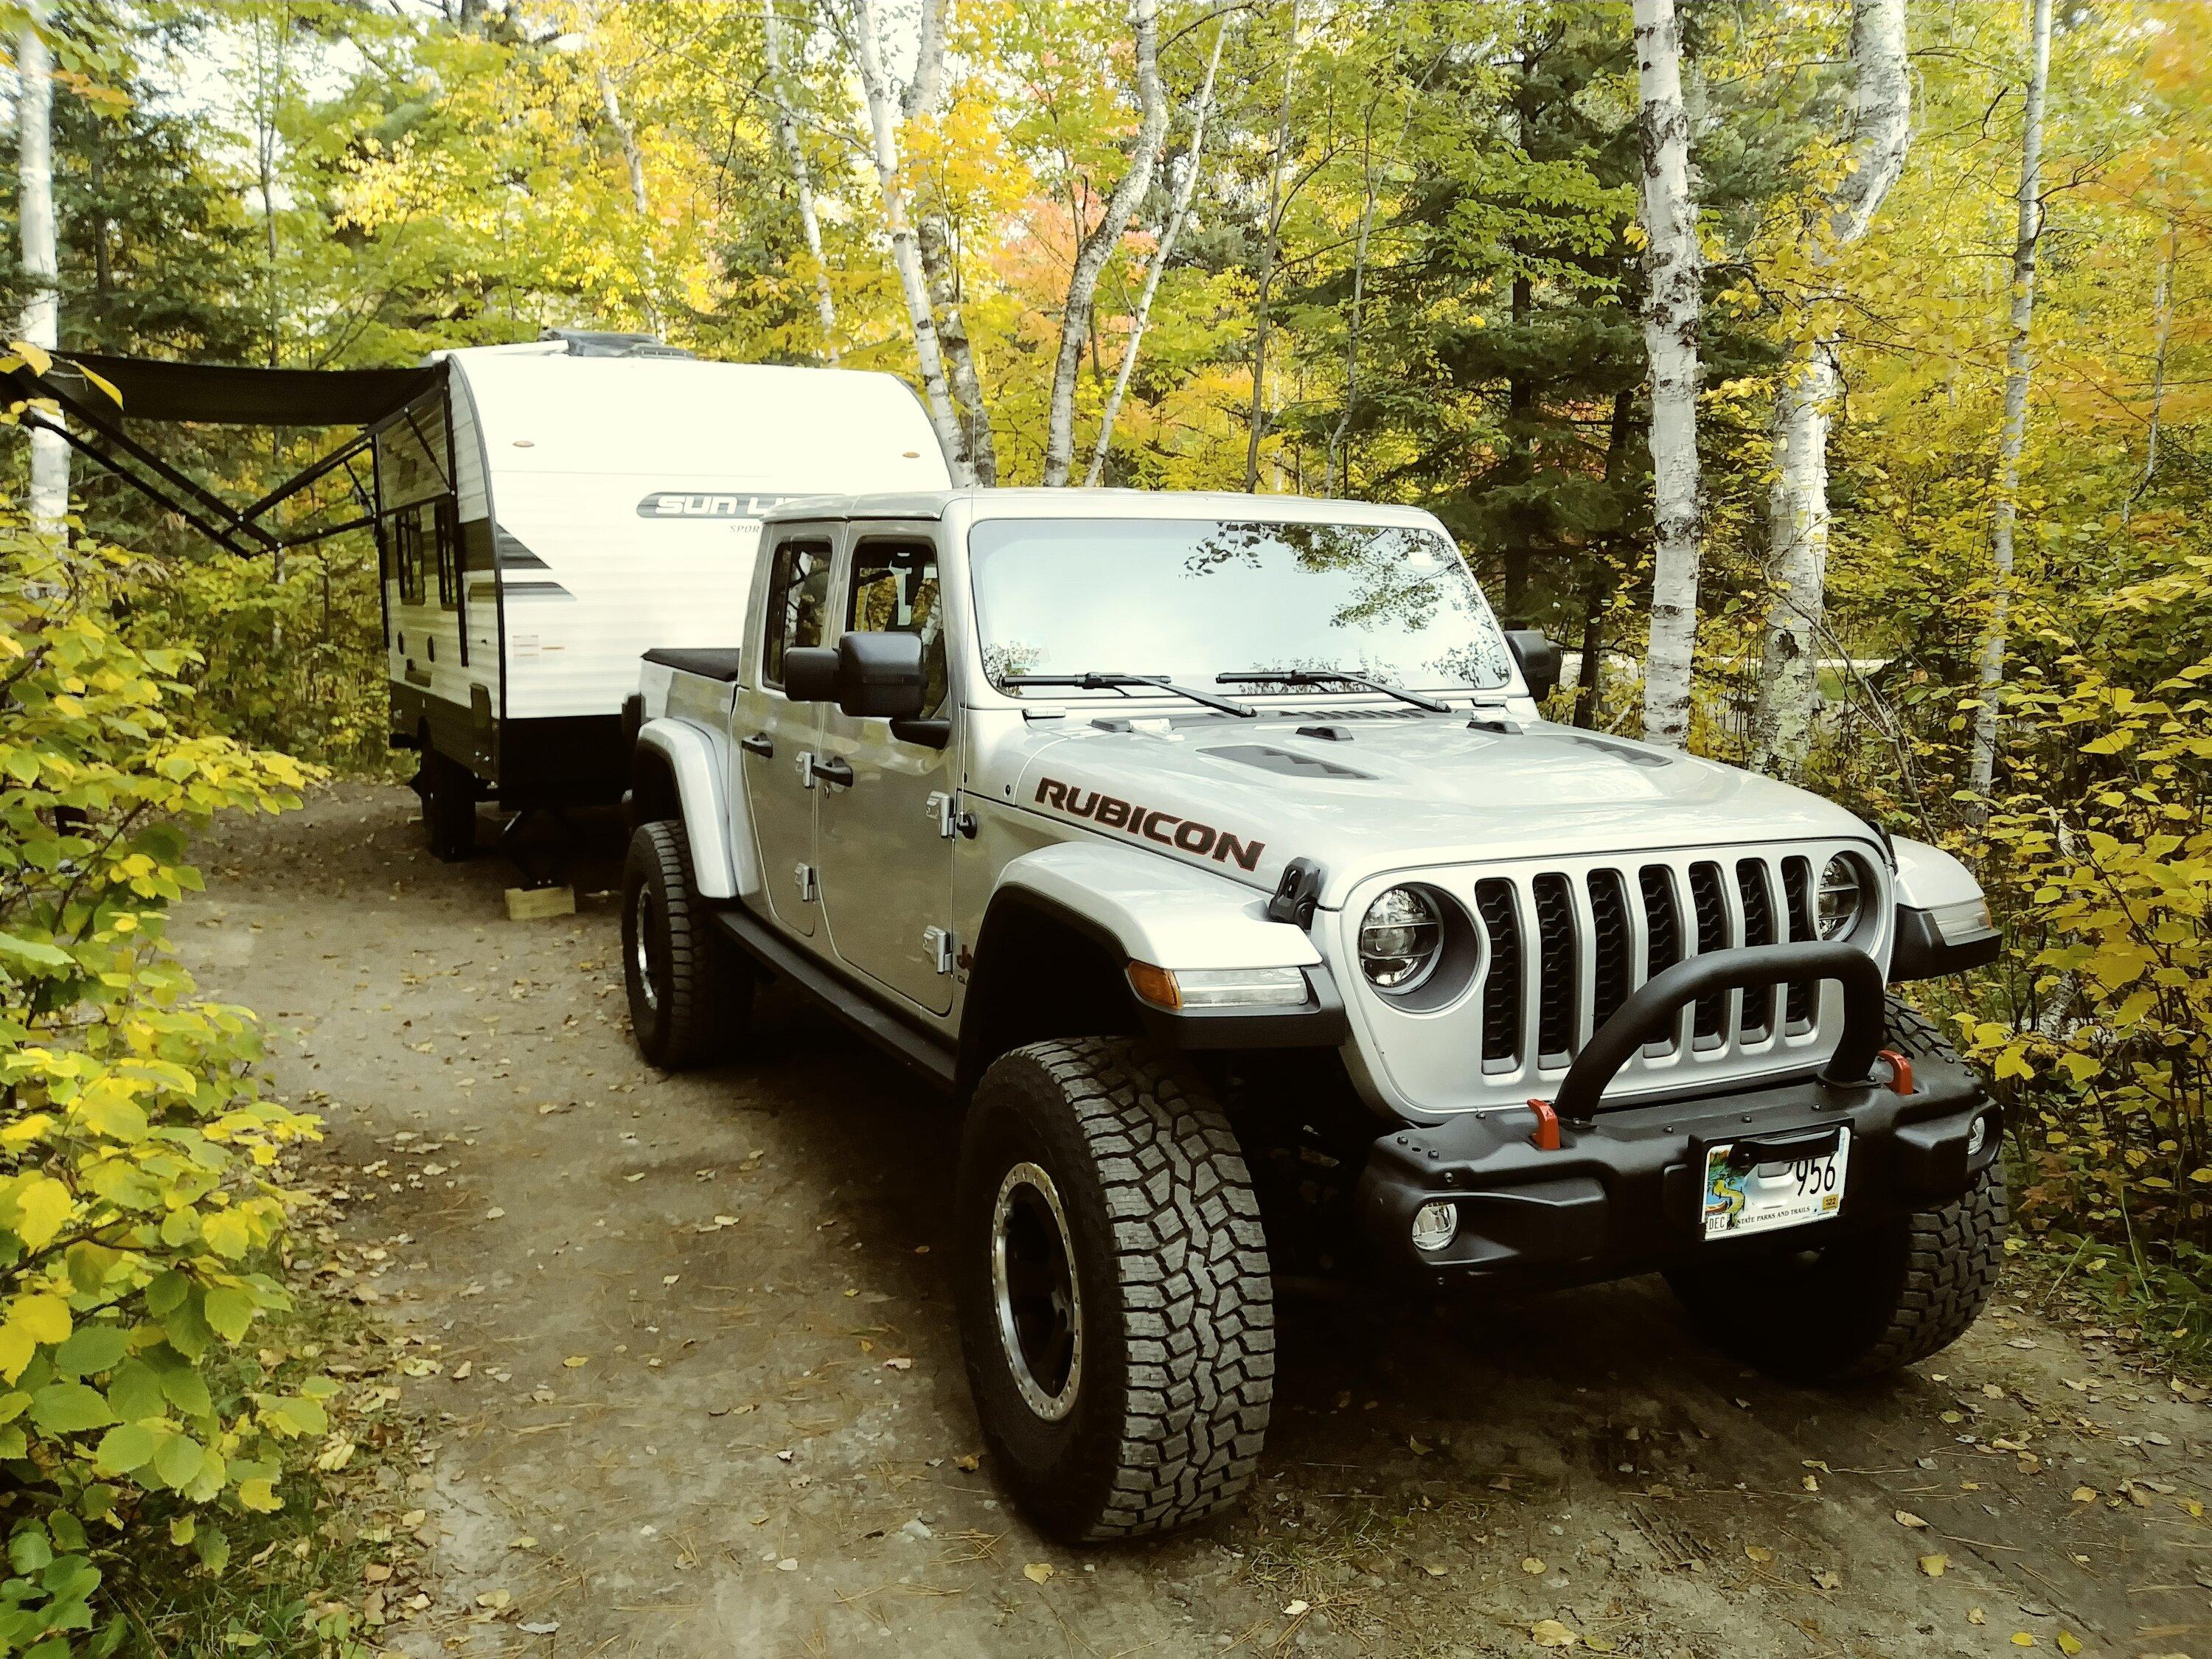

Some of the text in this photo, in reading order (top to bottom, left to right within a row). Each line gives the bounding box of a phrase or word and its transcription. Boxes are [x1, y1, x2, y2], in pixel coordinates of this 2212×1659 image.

[655, 495, 737, 515] SUN
[1034, 776, 1266, 872] RUBICON
[1708, 1217, 1725, 1230] DEC
[1737, 1206, 1810, 1225] STATE PARKS AND TRAILS
